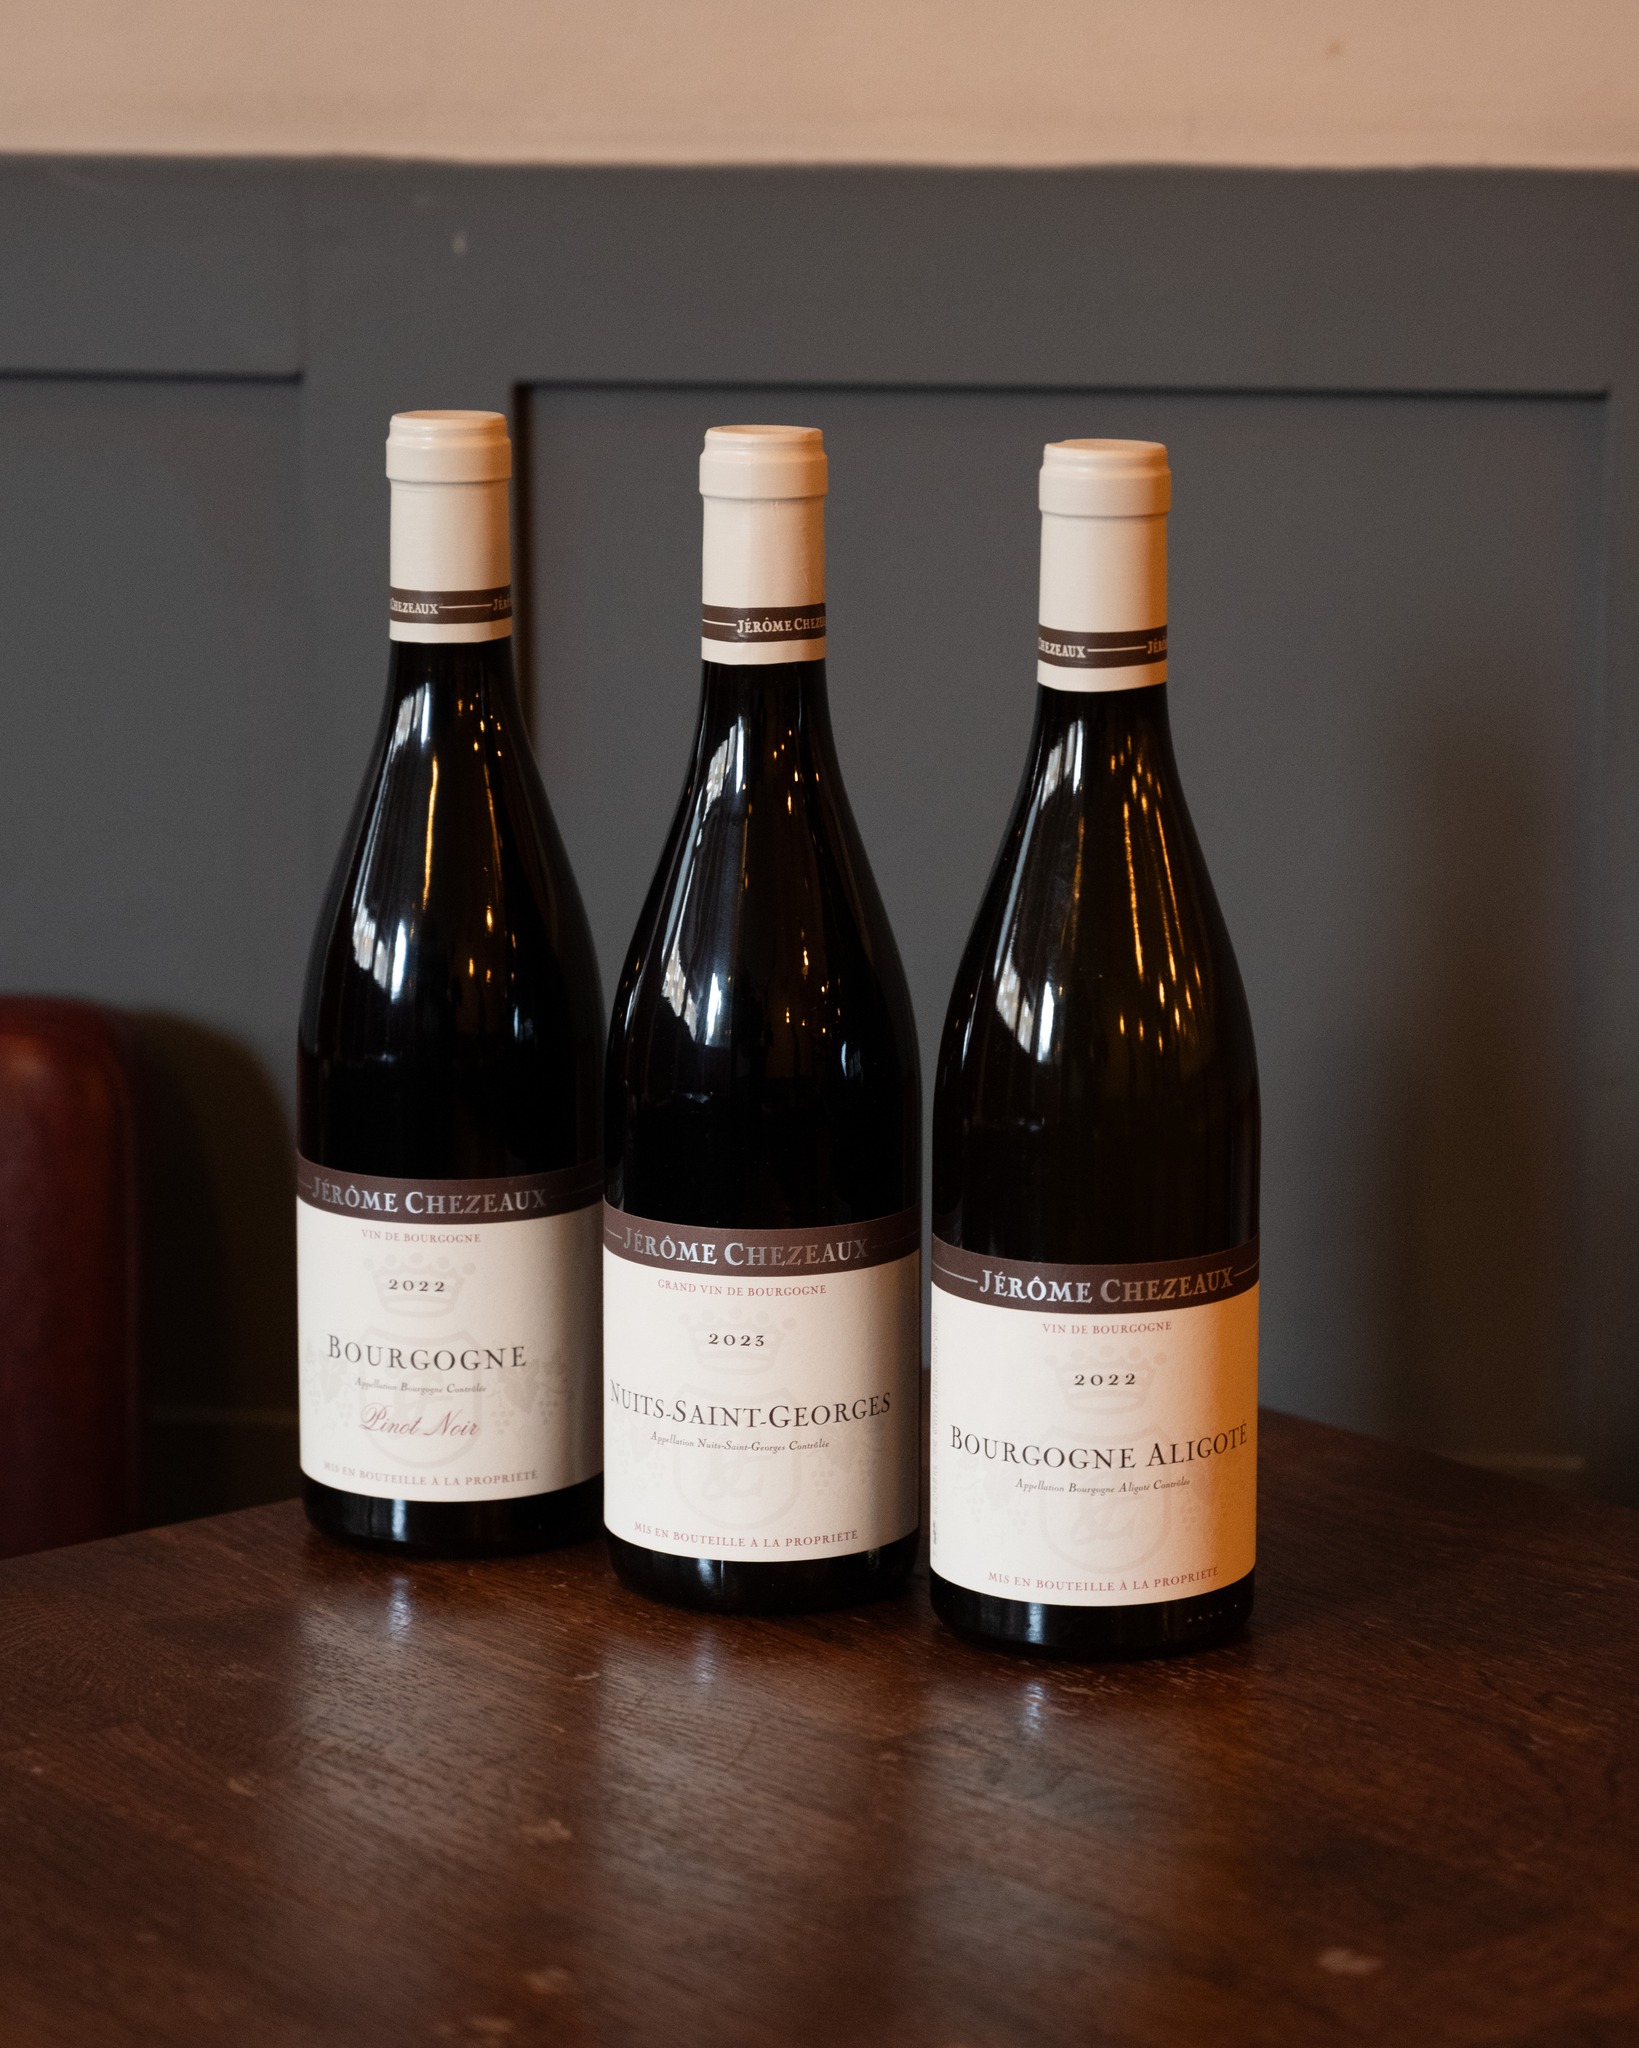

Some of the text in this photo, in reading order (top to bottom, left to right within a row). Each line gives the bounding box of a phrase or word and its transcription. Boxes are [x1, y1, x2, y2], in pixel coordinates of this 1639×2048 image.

[737, 617, 793, 633] JÉRÔME
[312, 1176, 548, 1216] JÉRÔME CHEZEAUX
[361, 1229, 482, 1244] VIN DE BOURGOGNE
[623, 1226, 870, 1268] JÉRÔME CHEZEAUX
[388, 1278, 446, 1293] 2022
[657, 1279, 828, 1298] GRAND VIN DE BOURGOGNE
[978, 1266, 1234, 1304] JÉRÔME CHEZEAUX
[1042, 1320, 1173, 1335] VIN DE BOURGOGNE
[707, 1332, 766, 1348] 2023
[327, 1334, 528, 1371] BOURGOGNE
[354, 1377, 397, 1390] Appellation
[400, 1382, 443, 1396] Bourgogne
[1073, 1372, 1138, 1387] 2022
[610, 1378, 892, 1429] NUITS-SAINT-GEORGES
[358, 1402, 482, 1437] Pinot Noir
[650, 1431, 831, 1455] Appellation Nuits-Saint-Georges Contrôlée
[949, 1419, 1248, 1470] BOURGOGNE ALIGOTÉ
[323, 1461, 340, 1473] MIS
[342, 1465, 356, 1477] EN
[359, 1470, 428, 1486] BOUTEILLE
[443, 1476, 461, 1487] LA
[1015, 1475, 1191, 1497] Appellation Bourgogne Aligoté Contrôlée
[634, 1520, 653, 1535] MIS
[654, 1527, 670, 1539] EN
[673, 1531, 746, 1548] BOUTEILLE
[763, 1538, 781, 1548] LA
[987, 1570, 1011, 1585] MIS
[1013, 1576, 1031, 1588] EN
[1036, 1579, 1115, 1592] BOUTEILLE
[1132, 1579, 1150, 1591] LA
